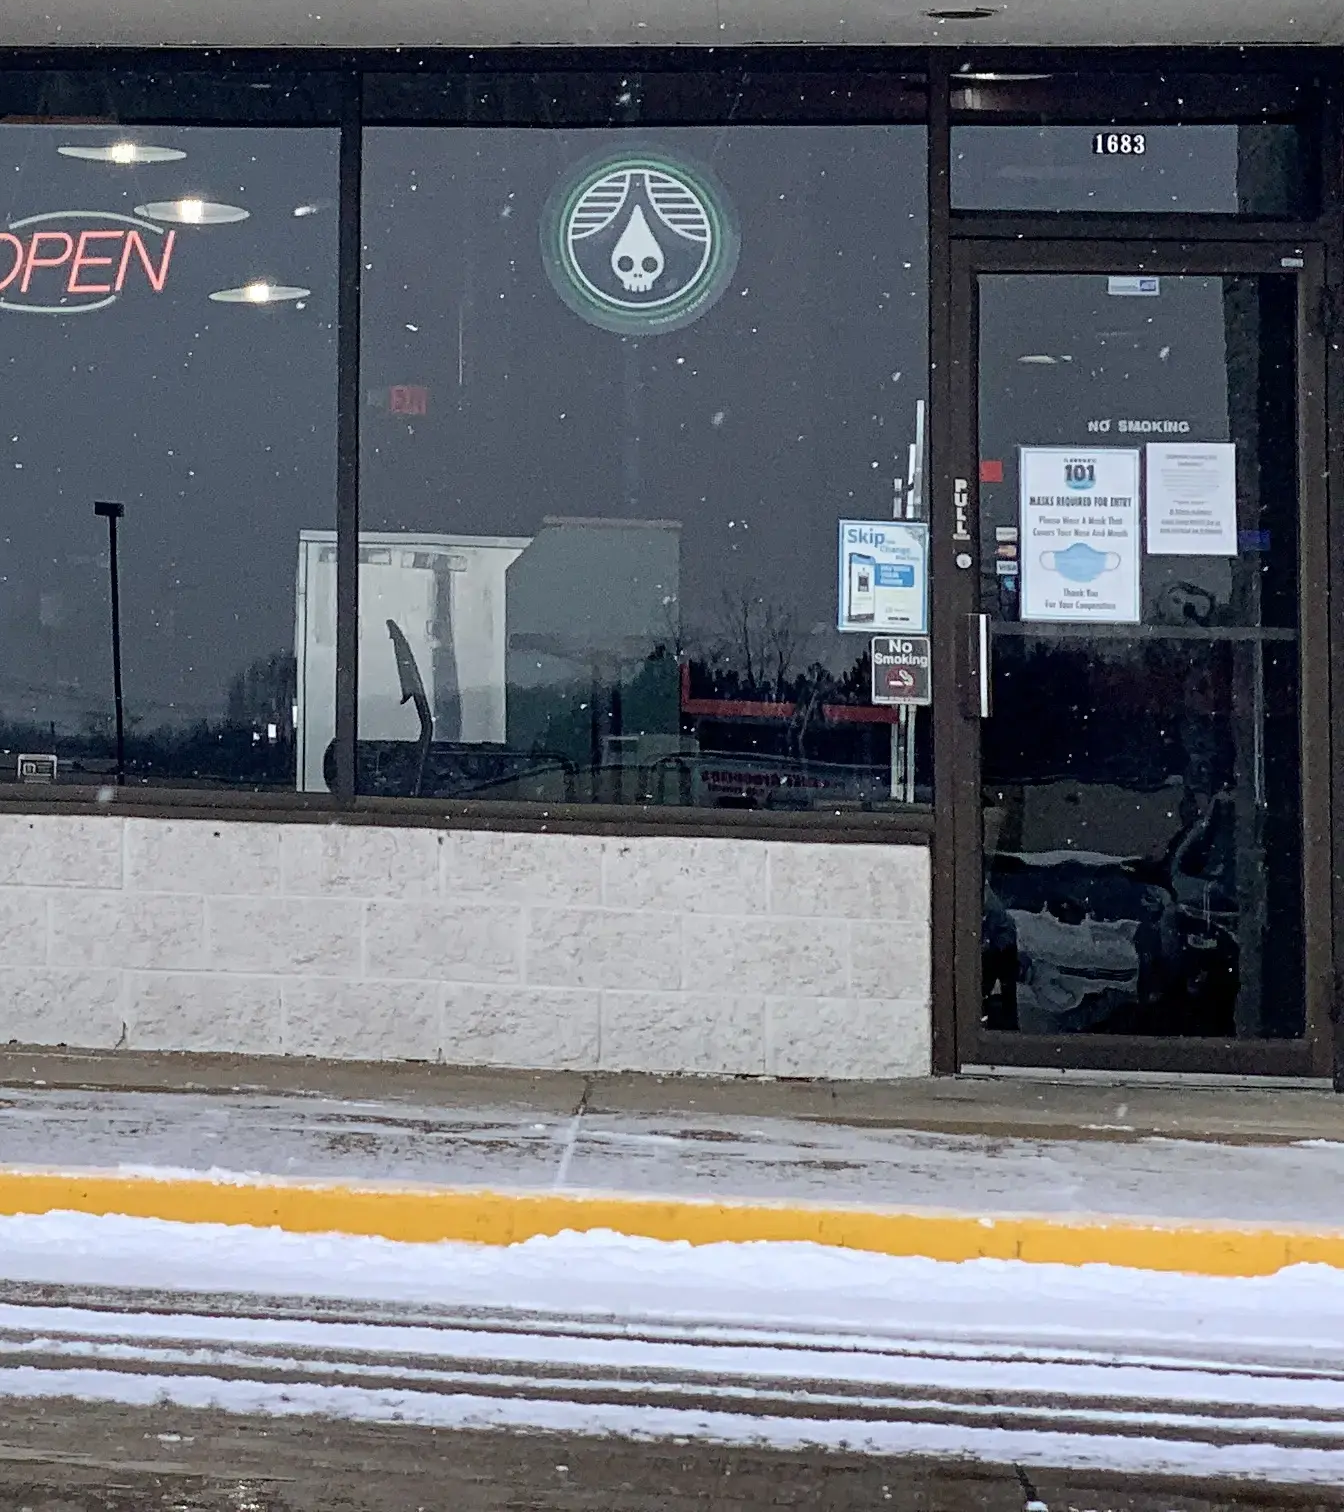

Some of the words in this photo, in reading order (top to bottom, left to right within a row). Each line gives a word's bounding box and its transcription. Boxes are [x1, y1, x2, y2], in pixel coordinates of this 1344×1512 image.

[1096, 134, 1145, 154] 1683
[1088, 419, 1111, 432] NO
[1118, 420, 1190, 433] SMOKING
[847, 528, 885, 548] Skip
[888, 639, 913, 653] No
[874, 652, 929, 668] Smoking
